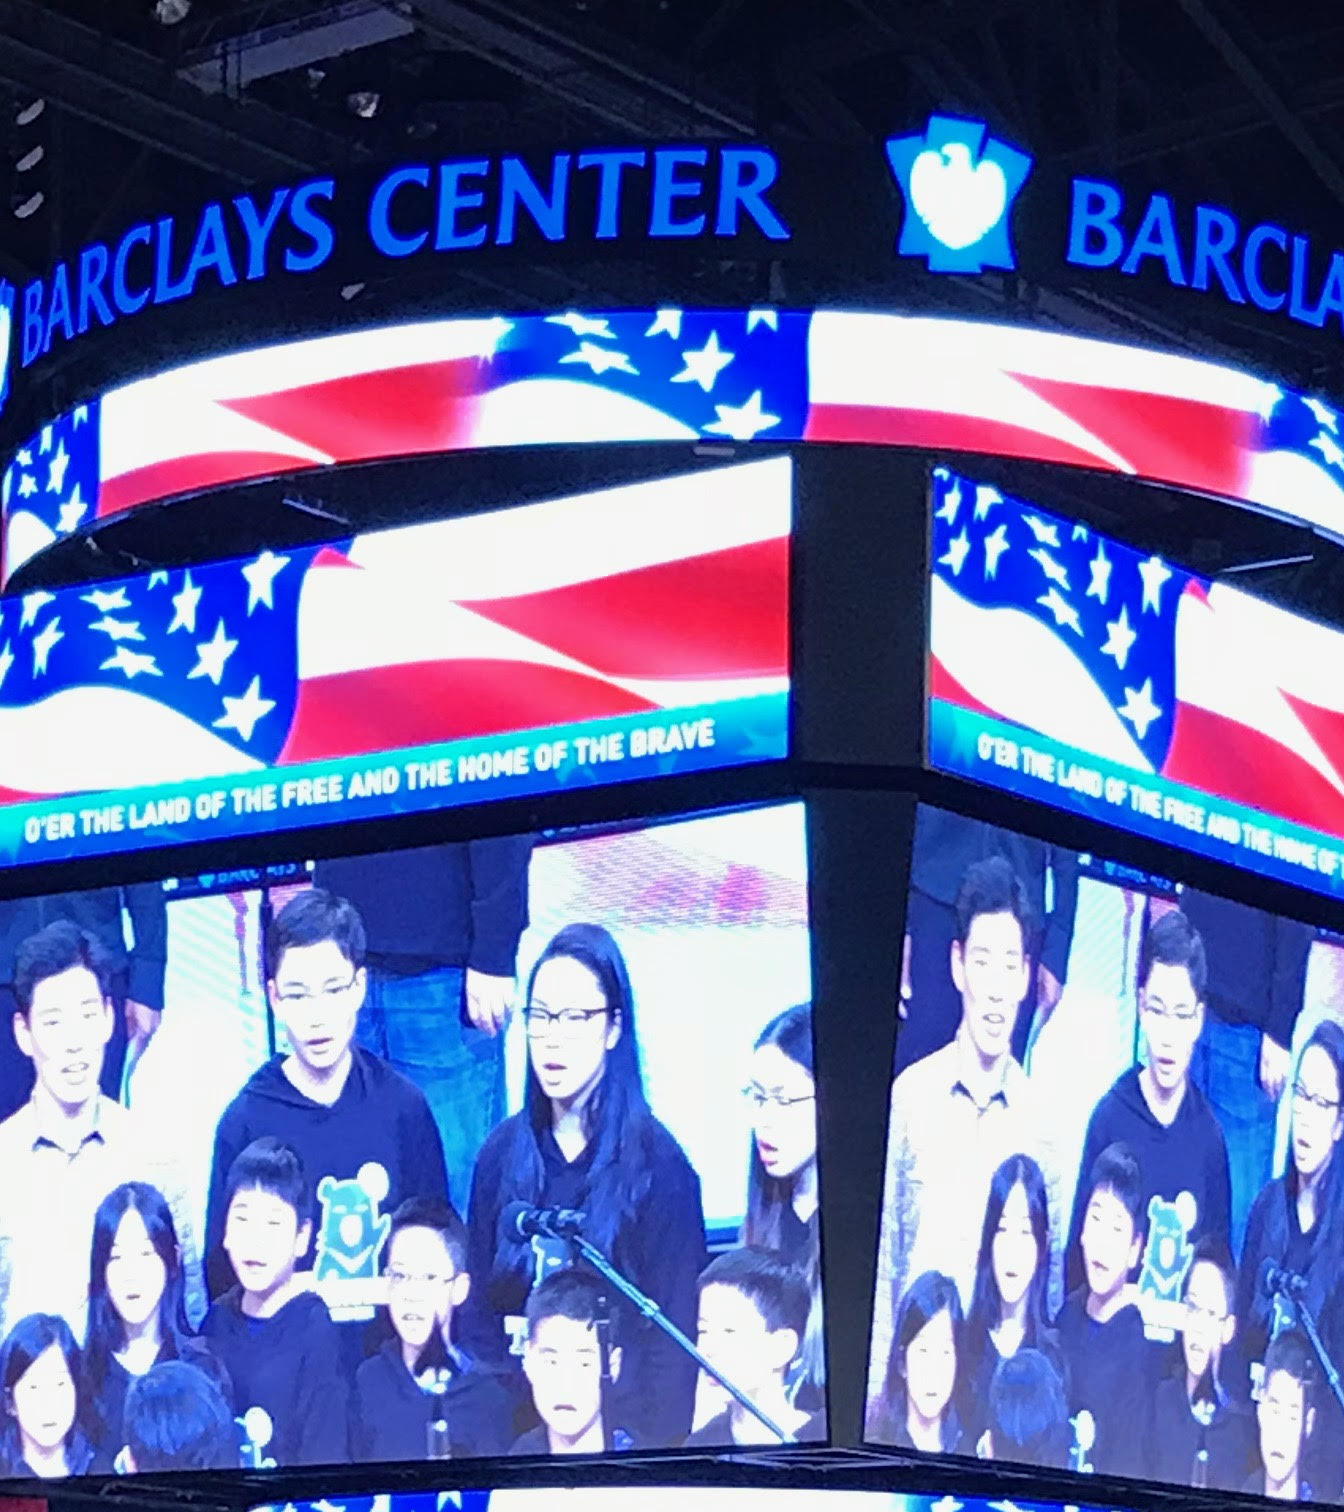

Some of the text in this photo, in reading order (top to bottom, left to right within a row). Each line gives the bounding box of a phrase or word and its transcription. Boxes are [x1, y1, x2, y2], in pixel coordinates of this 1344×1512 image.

[22, 146, 792, 368] BARCLAYS CENTER
[24, 718, 716, 843] O'ER THE LAND OF THE FREE AND THE HOME OF THE BRAVE
[1021, 746, 1055, 783] THE
[1057, 759, 1103, 799] LAND
[1105, 776, 1128, 806] OF
[1128, 784, 1162, 819] THE
